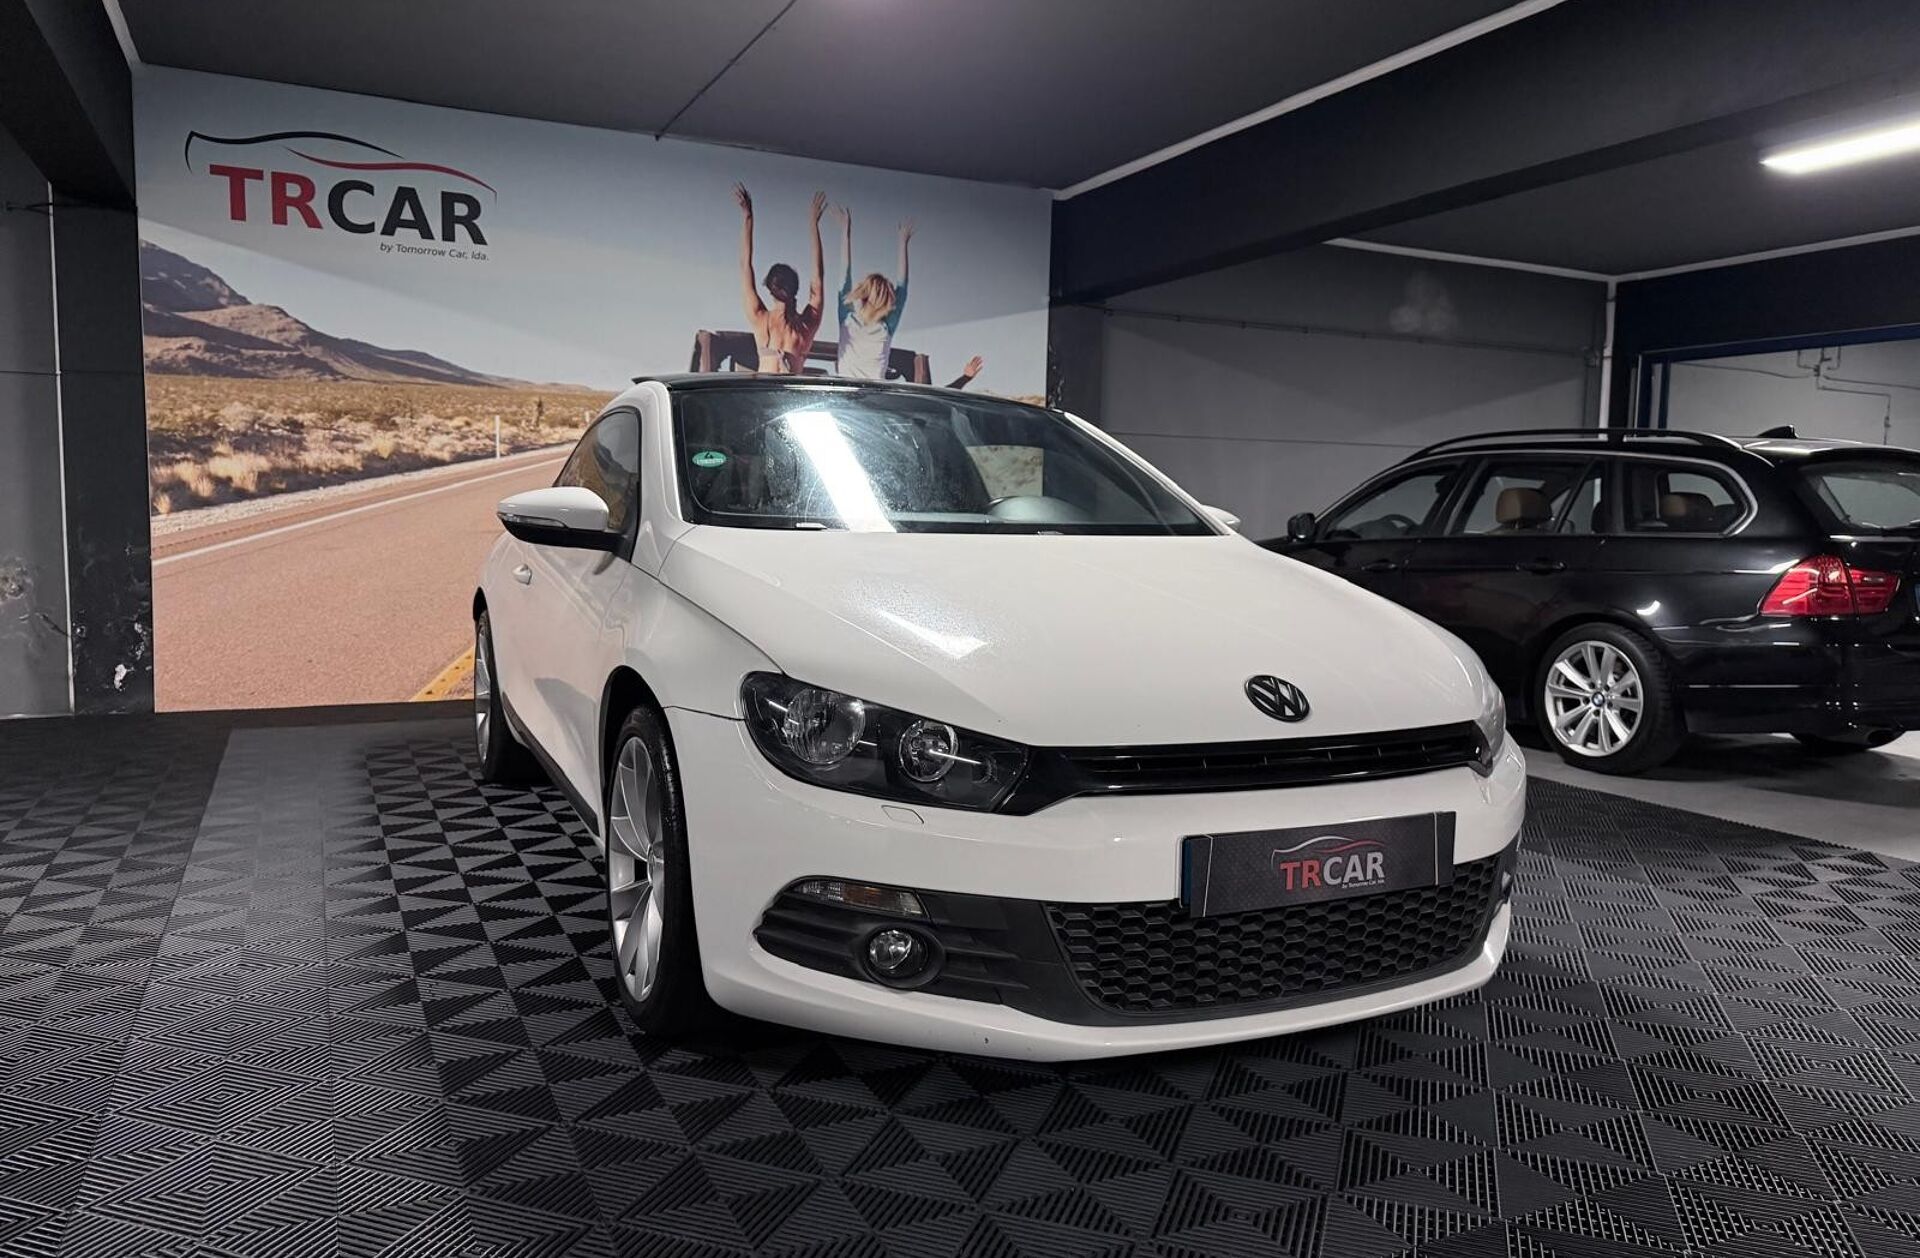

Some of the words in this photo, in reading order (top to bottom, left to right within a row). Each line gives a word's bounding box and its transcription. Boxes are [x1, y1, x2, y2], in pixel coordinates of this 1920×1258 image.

[209, 164, 489, 246] TRCAR
[380, 242, 393, 253] by
[396, 243, 446, 257] Tomorrow
[1280, 851, 1385, 890] TRCAR
